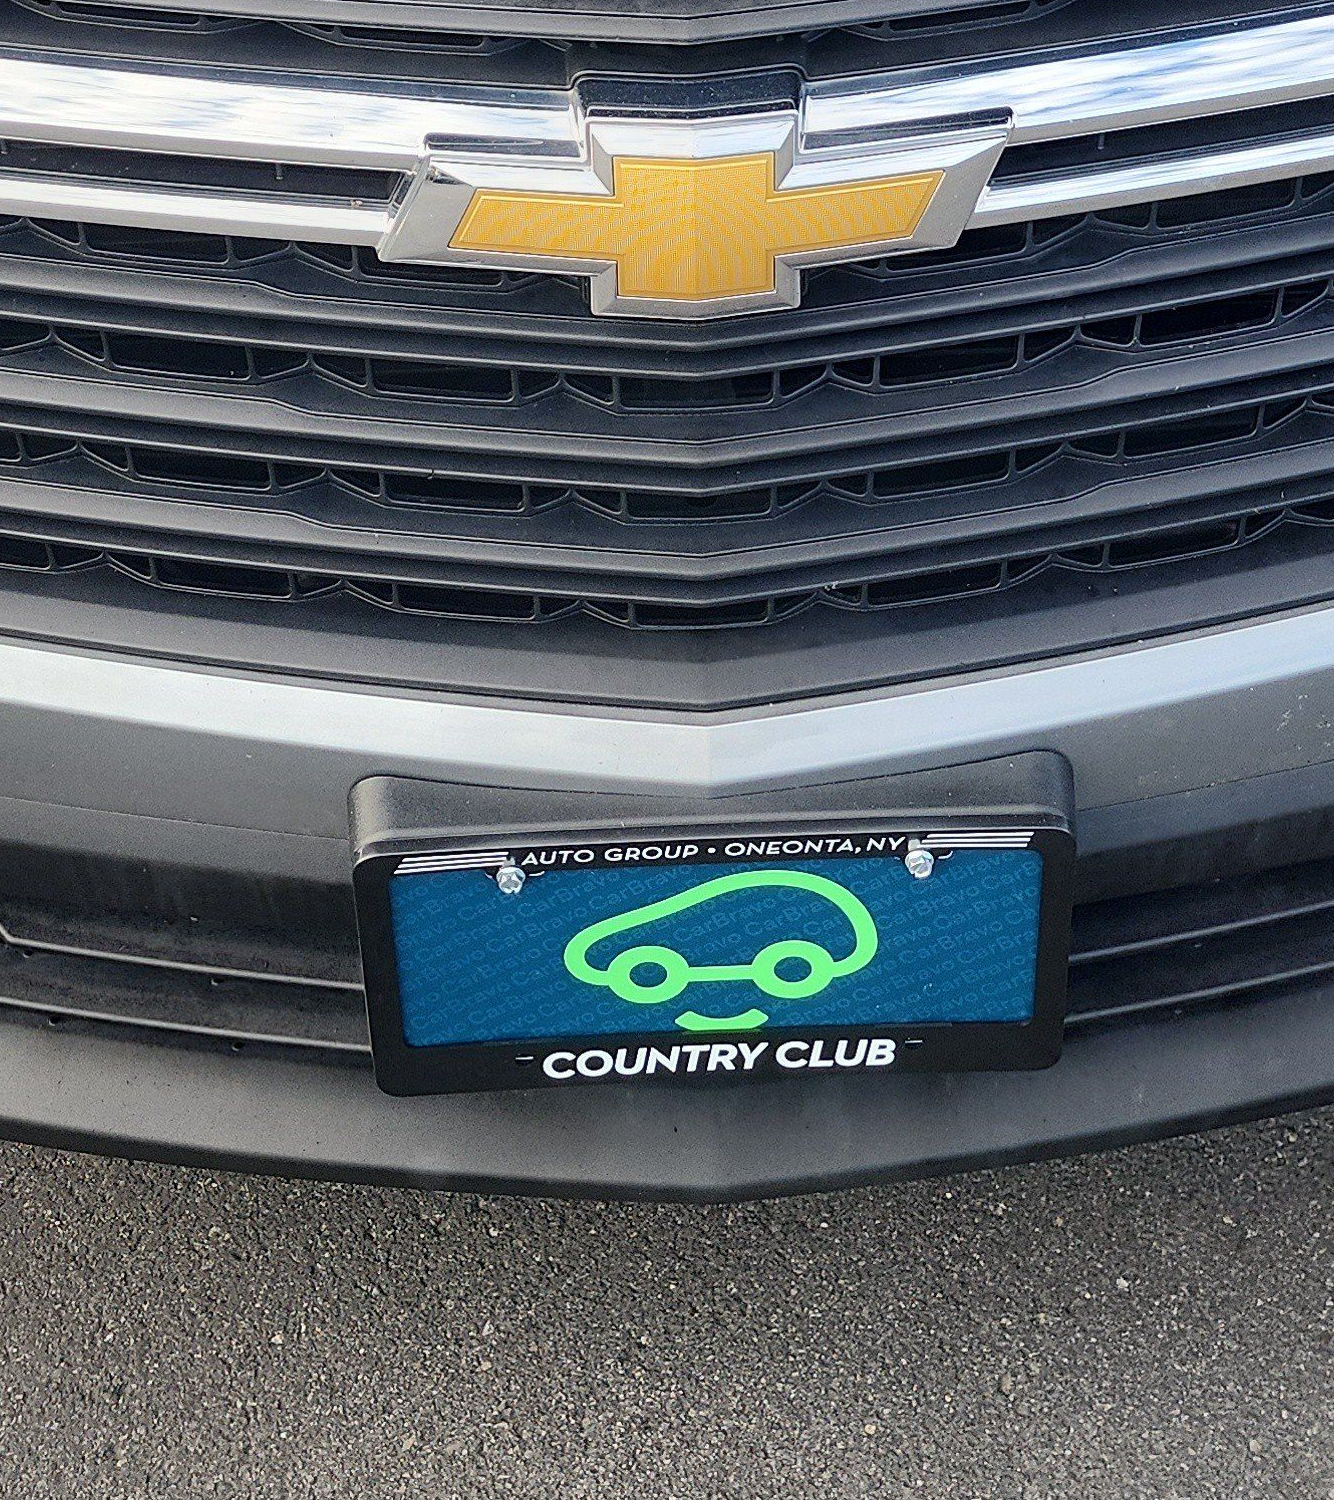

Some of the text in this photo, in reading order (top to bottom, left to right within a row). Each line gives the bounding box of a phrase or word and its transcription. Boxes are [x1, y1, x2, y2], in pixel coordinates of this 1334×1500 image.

[521, 837, 905, 866] AUTO GROUP ONEONTA, NY
[543, 1039, 895, 1078] COUNTRY CLUB
